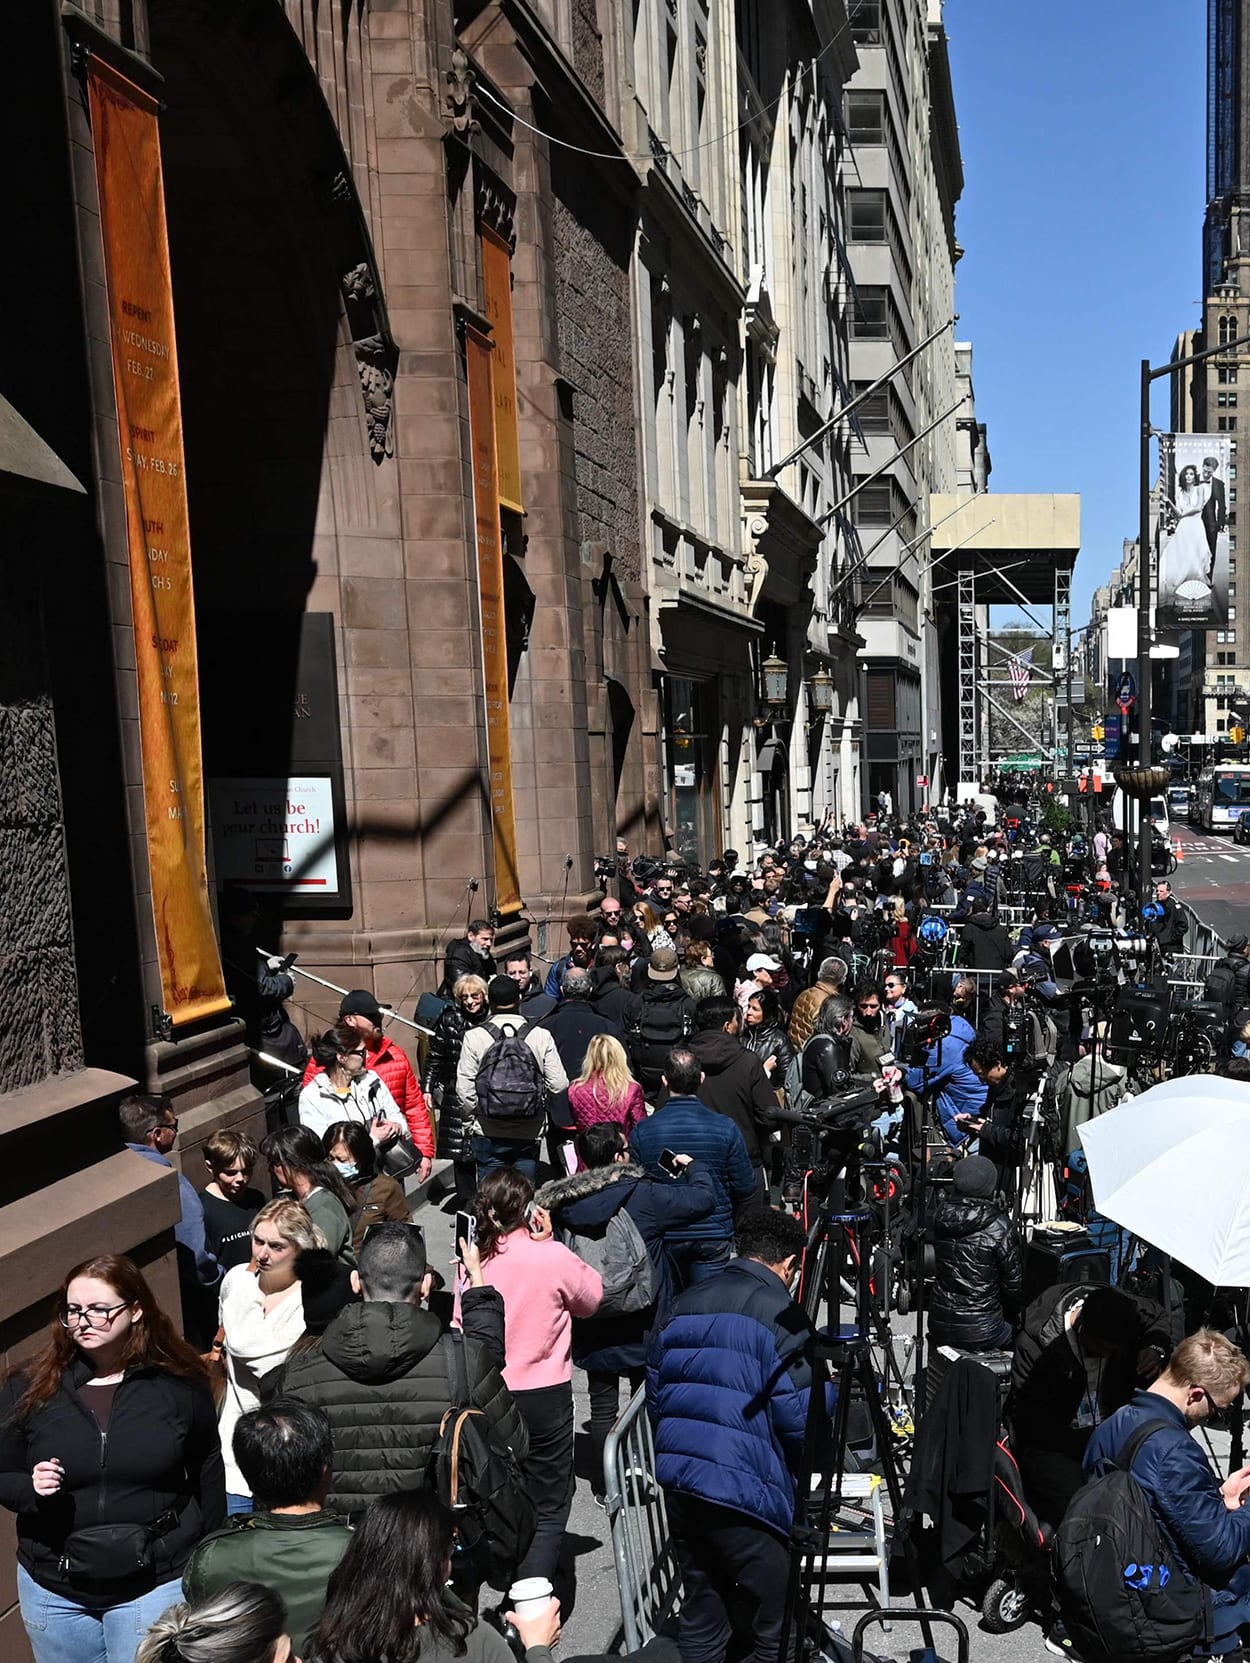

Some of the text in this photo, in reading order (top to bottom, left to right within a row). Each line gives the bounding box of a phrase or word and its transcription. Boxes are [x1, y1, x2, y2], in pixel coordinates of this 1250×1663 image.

[122, 300, 152, 323] REPENT
[122, 329, 170, 360] WEDNESDAY
[148, 548, 169, 562] NDAY
[234, 799, 306, 815] Let us be
[222, 818, 320, 836] your church!
